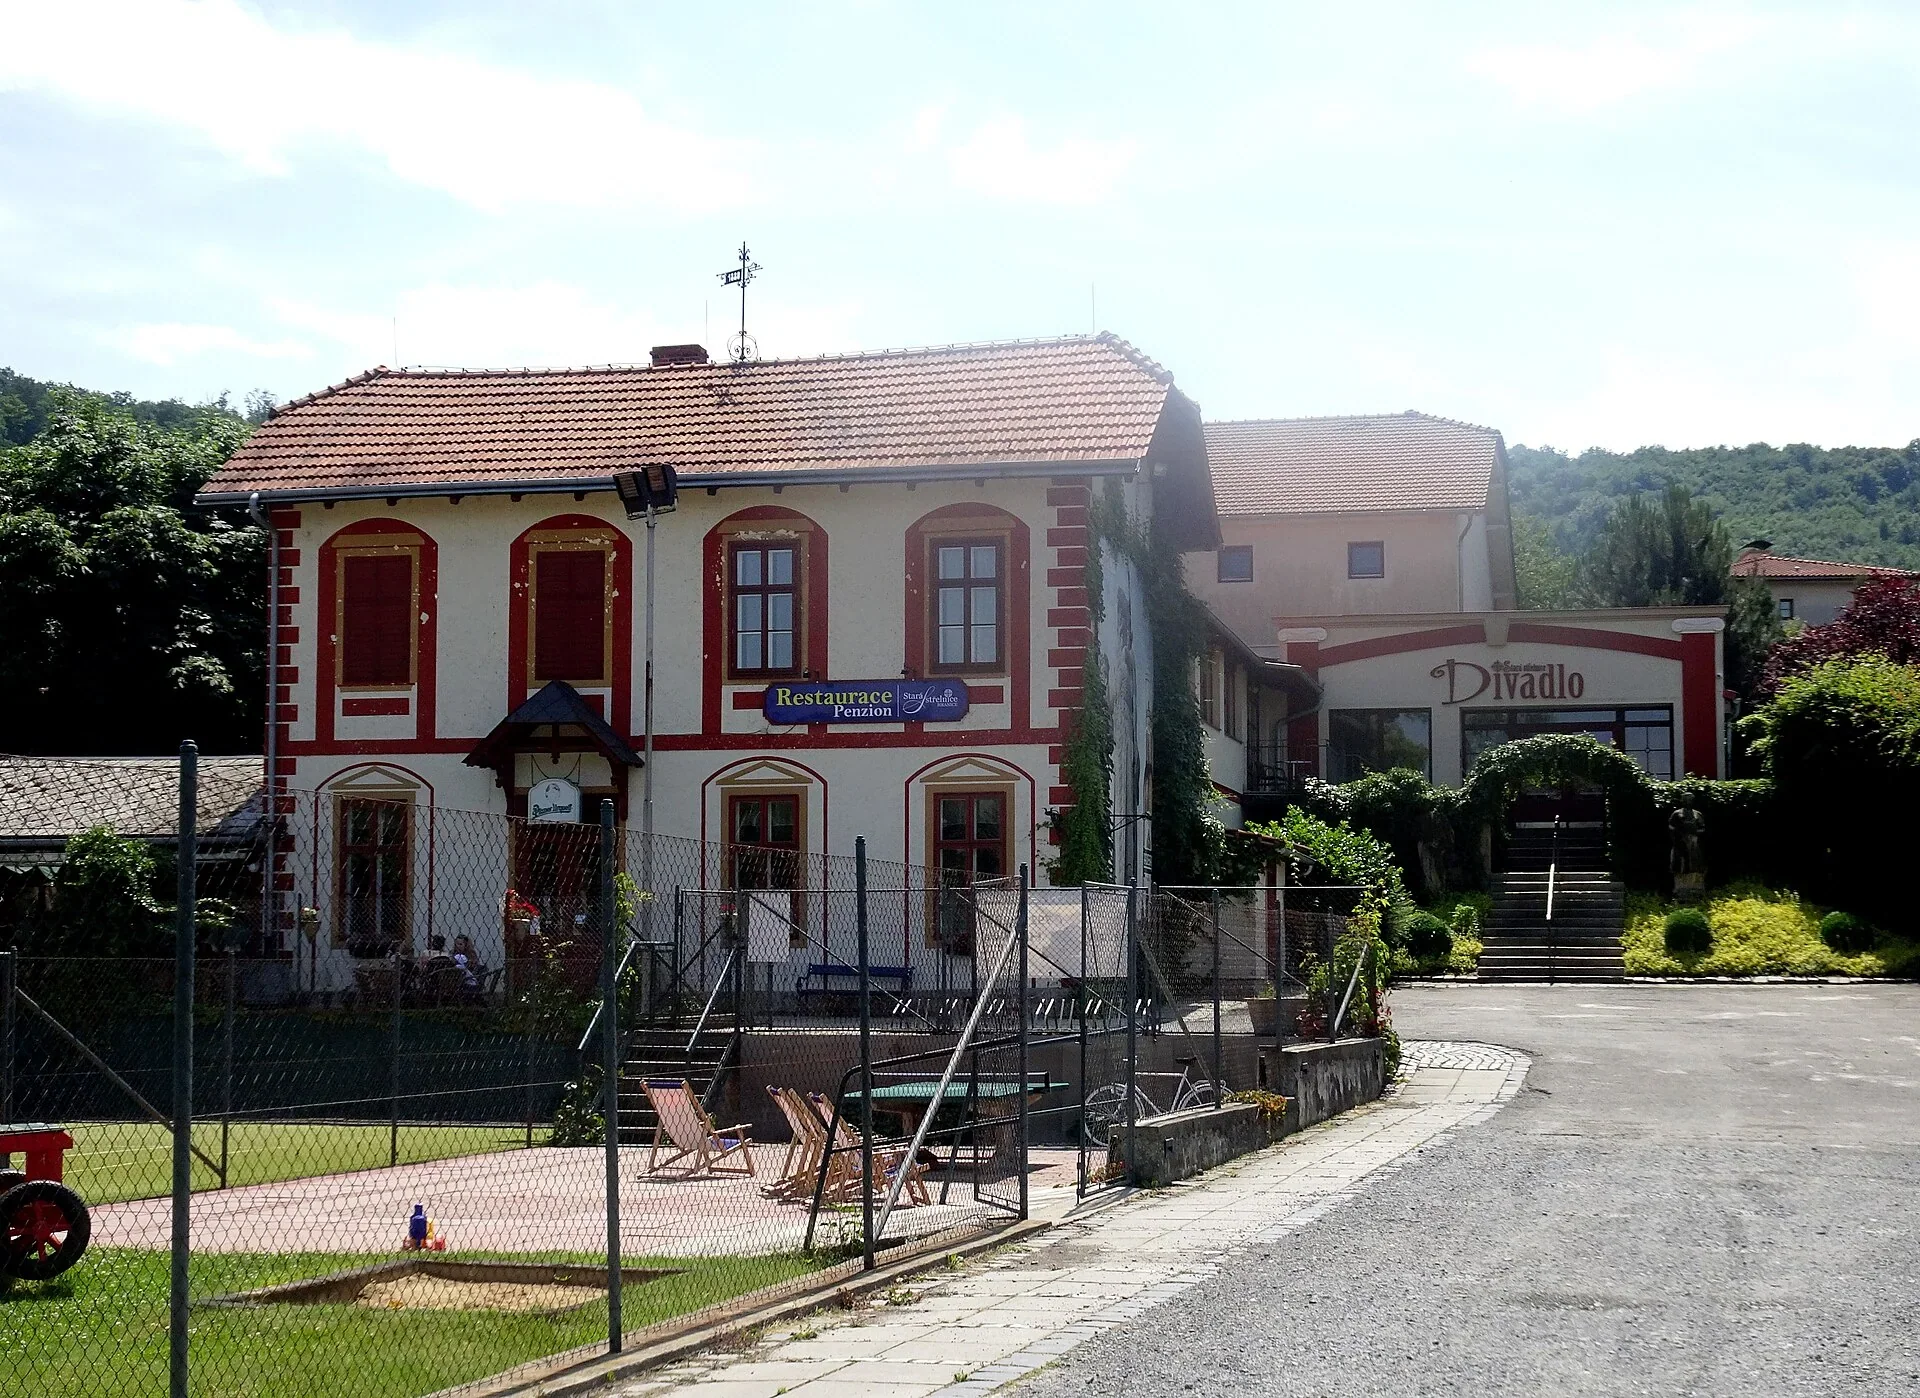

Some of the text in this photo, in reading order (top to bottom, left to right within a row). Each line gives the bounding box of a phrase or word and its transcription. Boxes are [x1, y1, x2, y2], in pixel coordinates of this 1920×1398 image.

[1430, 658, 1584, 705] Divadlo
[776, 688, 893, 706] Restaurace
[903, 691, 923, 700] Stará
[833, 704, 892, 718] Penzion
